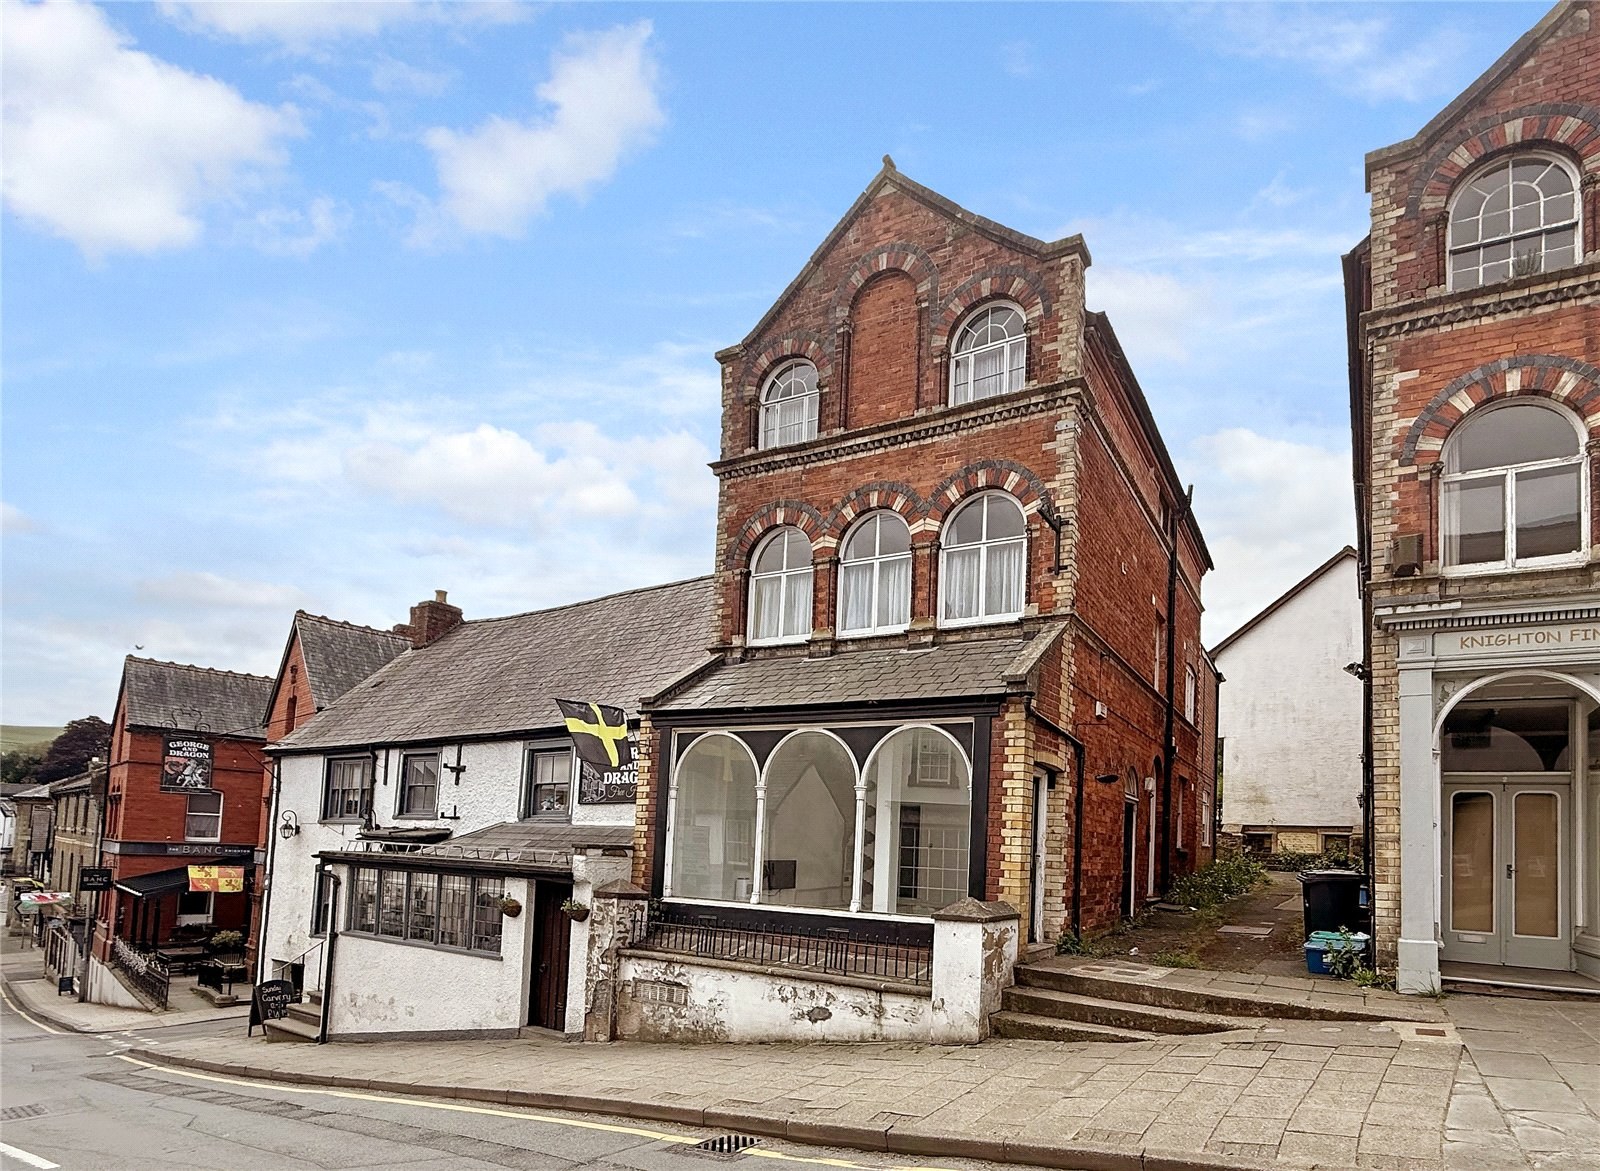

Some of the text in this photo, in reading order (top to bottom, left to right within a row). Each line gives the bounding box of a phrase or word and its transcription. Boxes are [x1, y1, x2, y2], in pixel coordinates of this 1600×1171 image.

[1460, 631, 1561, 649] KNIGHTON
[169, 741, 210, 751] GEORGE
[169, 750, 210, 759] DRAGON
[182, 845, 222, 855] BANC
